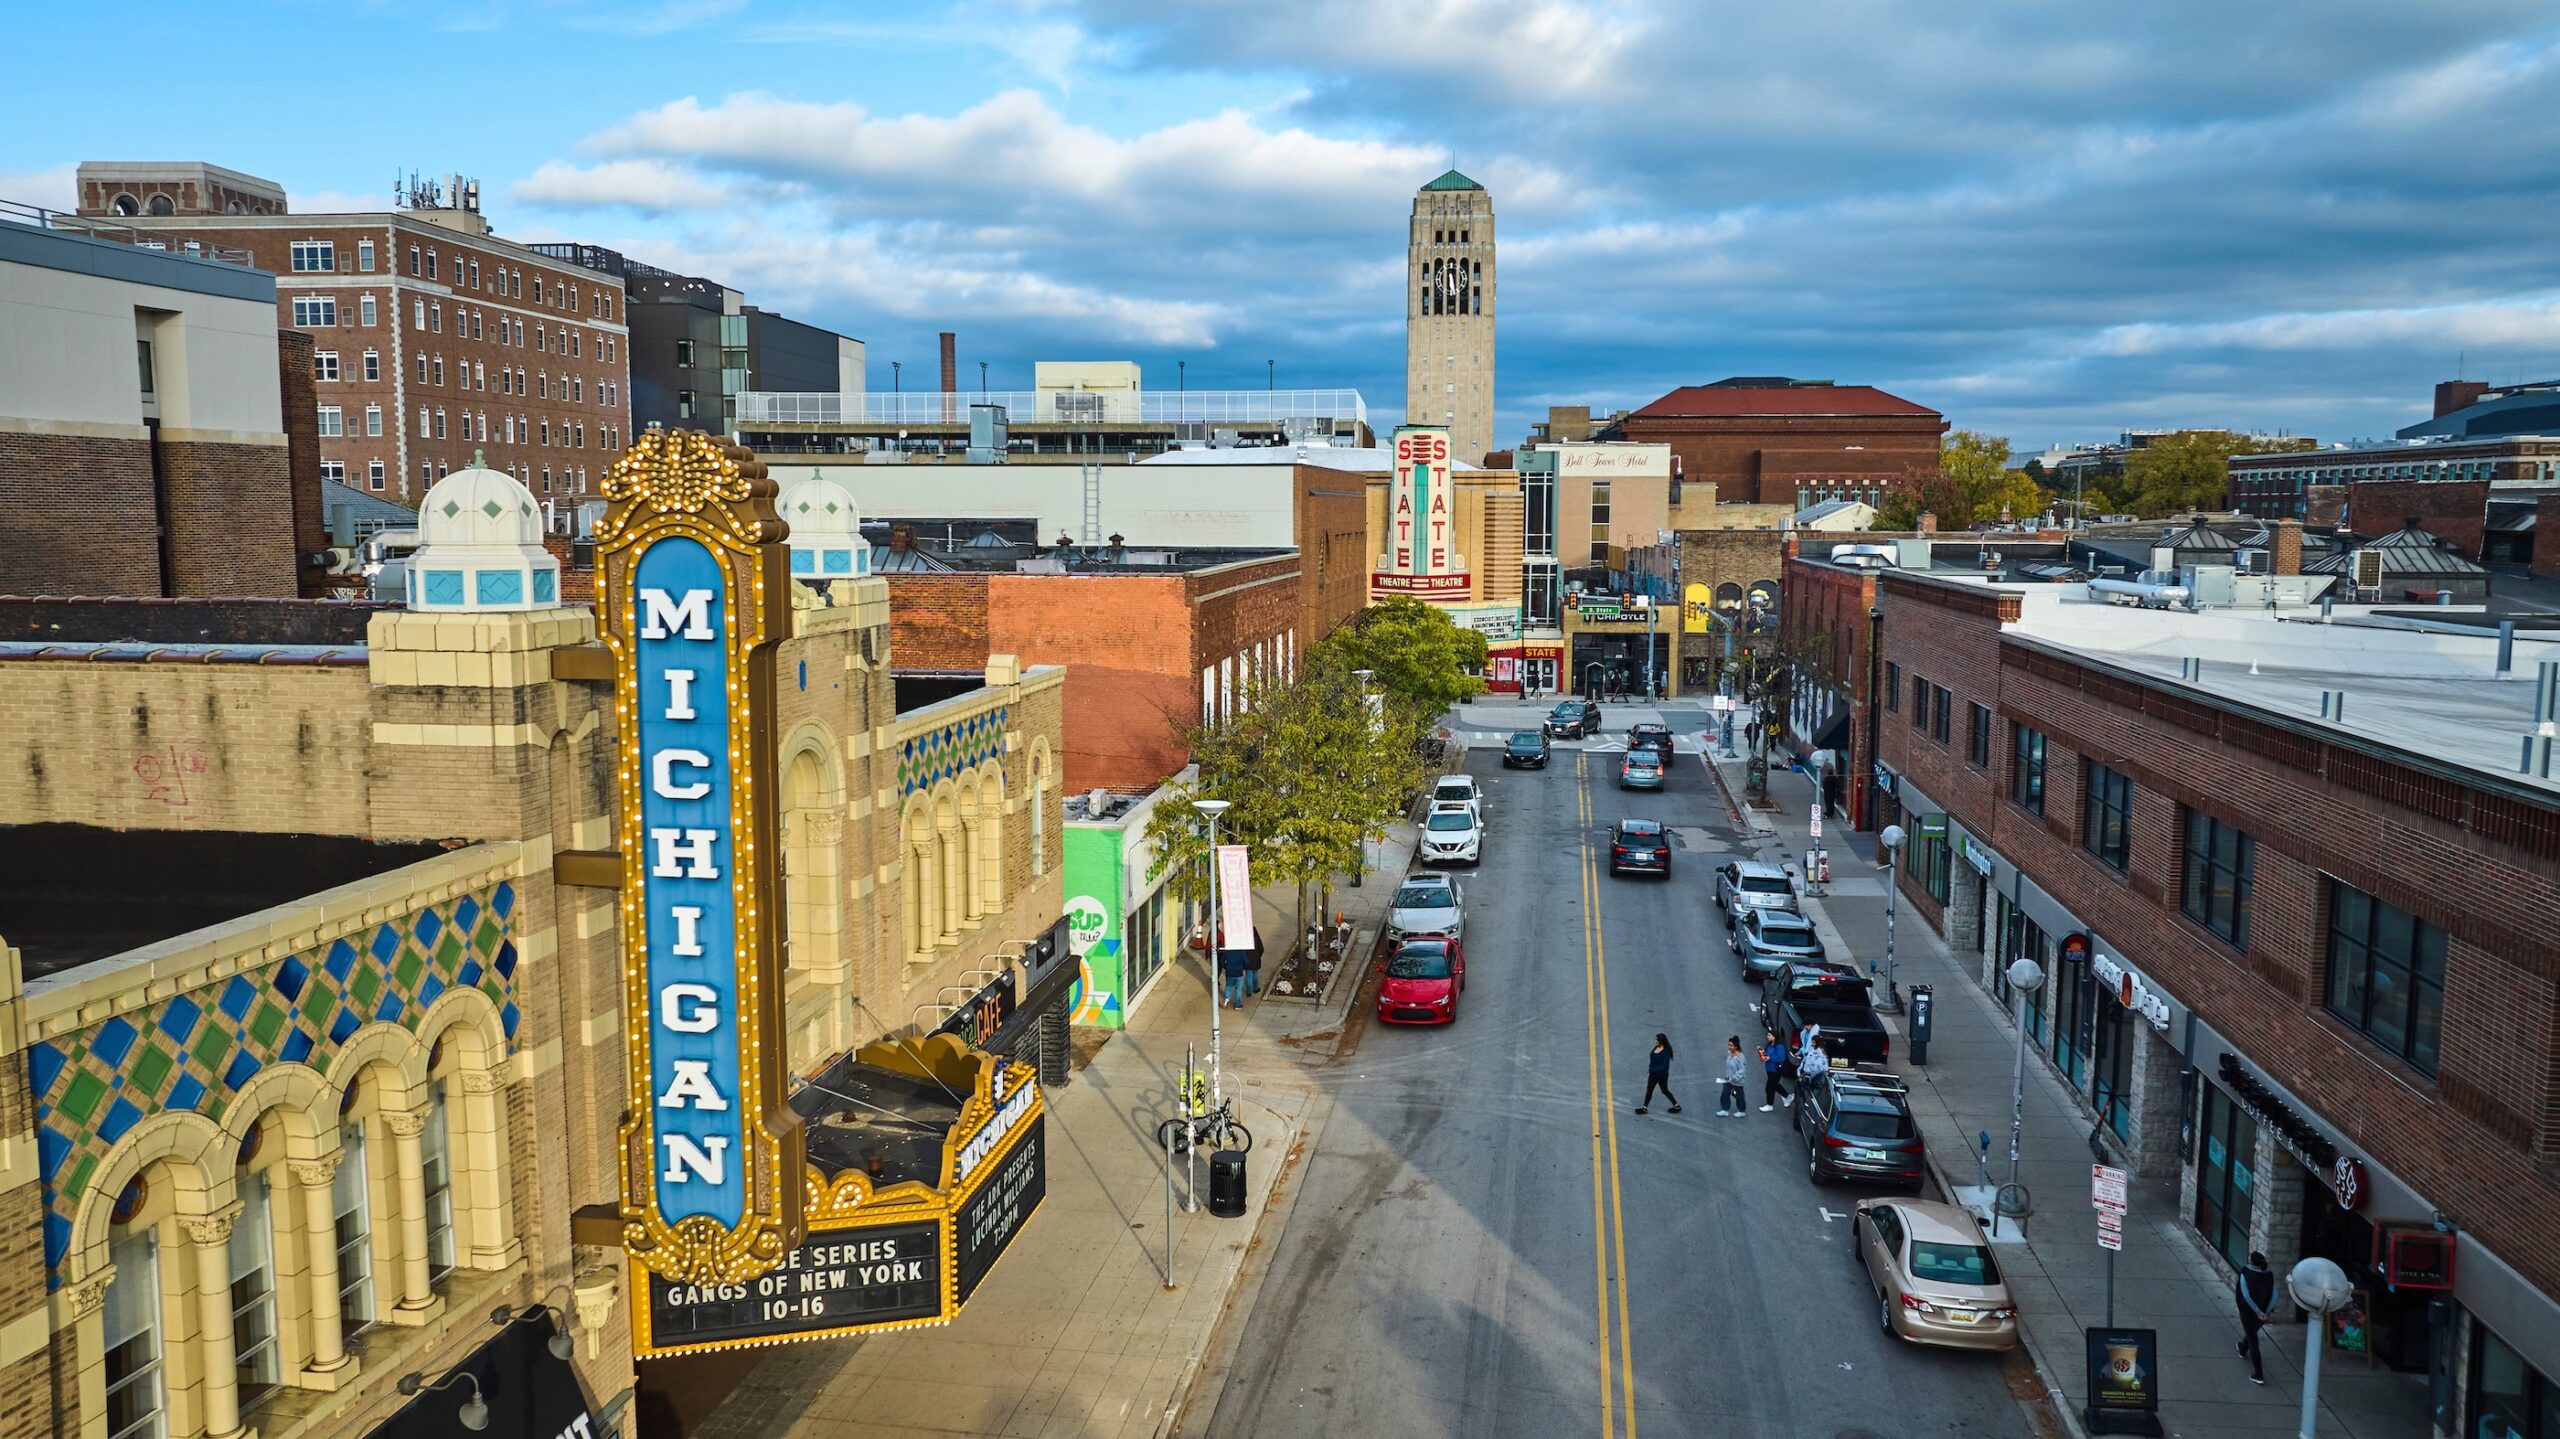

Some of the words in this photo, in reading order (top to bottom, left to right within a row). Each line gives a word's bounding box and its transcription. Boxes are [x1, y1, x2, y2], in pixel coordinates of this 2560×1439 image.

[1564, 453, 1584, 468] Bell
[1586, 452, 1616, 468] Tower
[1618, 452, 1649, 468] Hotel
[1397, 439, 1412, 568] STATE
[1432, 439, 1447, 568] STATE
[1379, 576, 1411, 588] THEATRE
[1430, 576, 1464, 588] THEATRE
[1525, 648, 1557, 657] STATE
[640, 587, 730, 1187] MICHIGAN
[977, 992, 1004, 1047] CAFE
[2240, 1096, 2284, 1141] COFFEE
[2287, 1137, 2295, 1151] &
[2298, 1149, 2322, 1176] TEA
[971, 1199, 985, 1228] THE
[987, 1180, 1001, 1211] ARK
[1003, 1139, 1036, 1190] PRESENTS
[2102, 1168, 2126, 1182] PARKING
[971, 1202, 1002, 1253] LUCINDA
[1003, 1161, 1035, 1211] WILLIAMS
[994, 1203, 1019, 1247] 7:30PM
[813, 1239, 897, 1267] SERIES
[667, 1283, 749, 1306] GANGS
[758, 1275, 789, 1297] OF
[800, 1270, 848, 1294] NEW
[858, 1261, 923, 1287] YORK
[763, 1296, 825, 1321] 10-16
